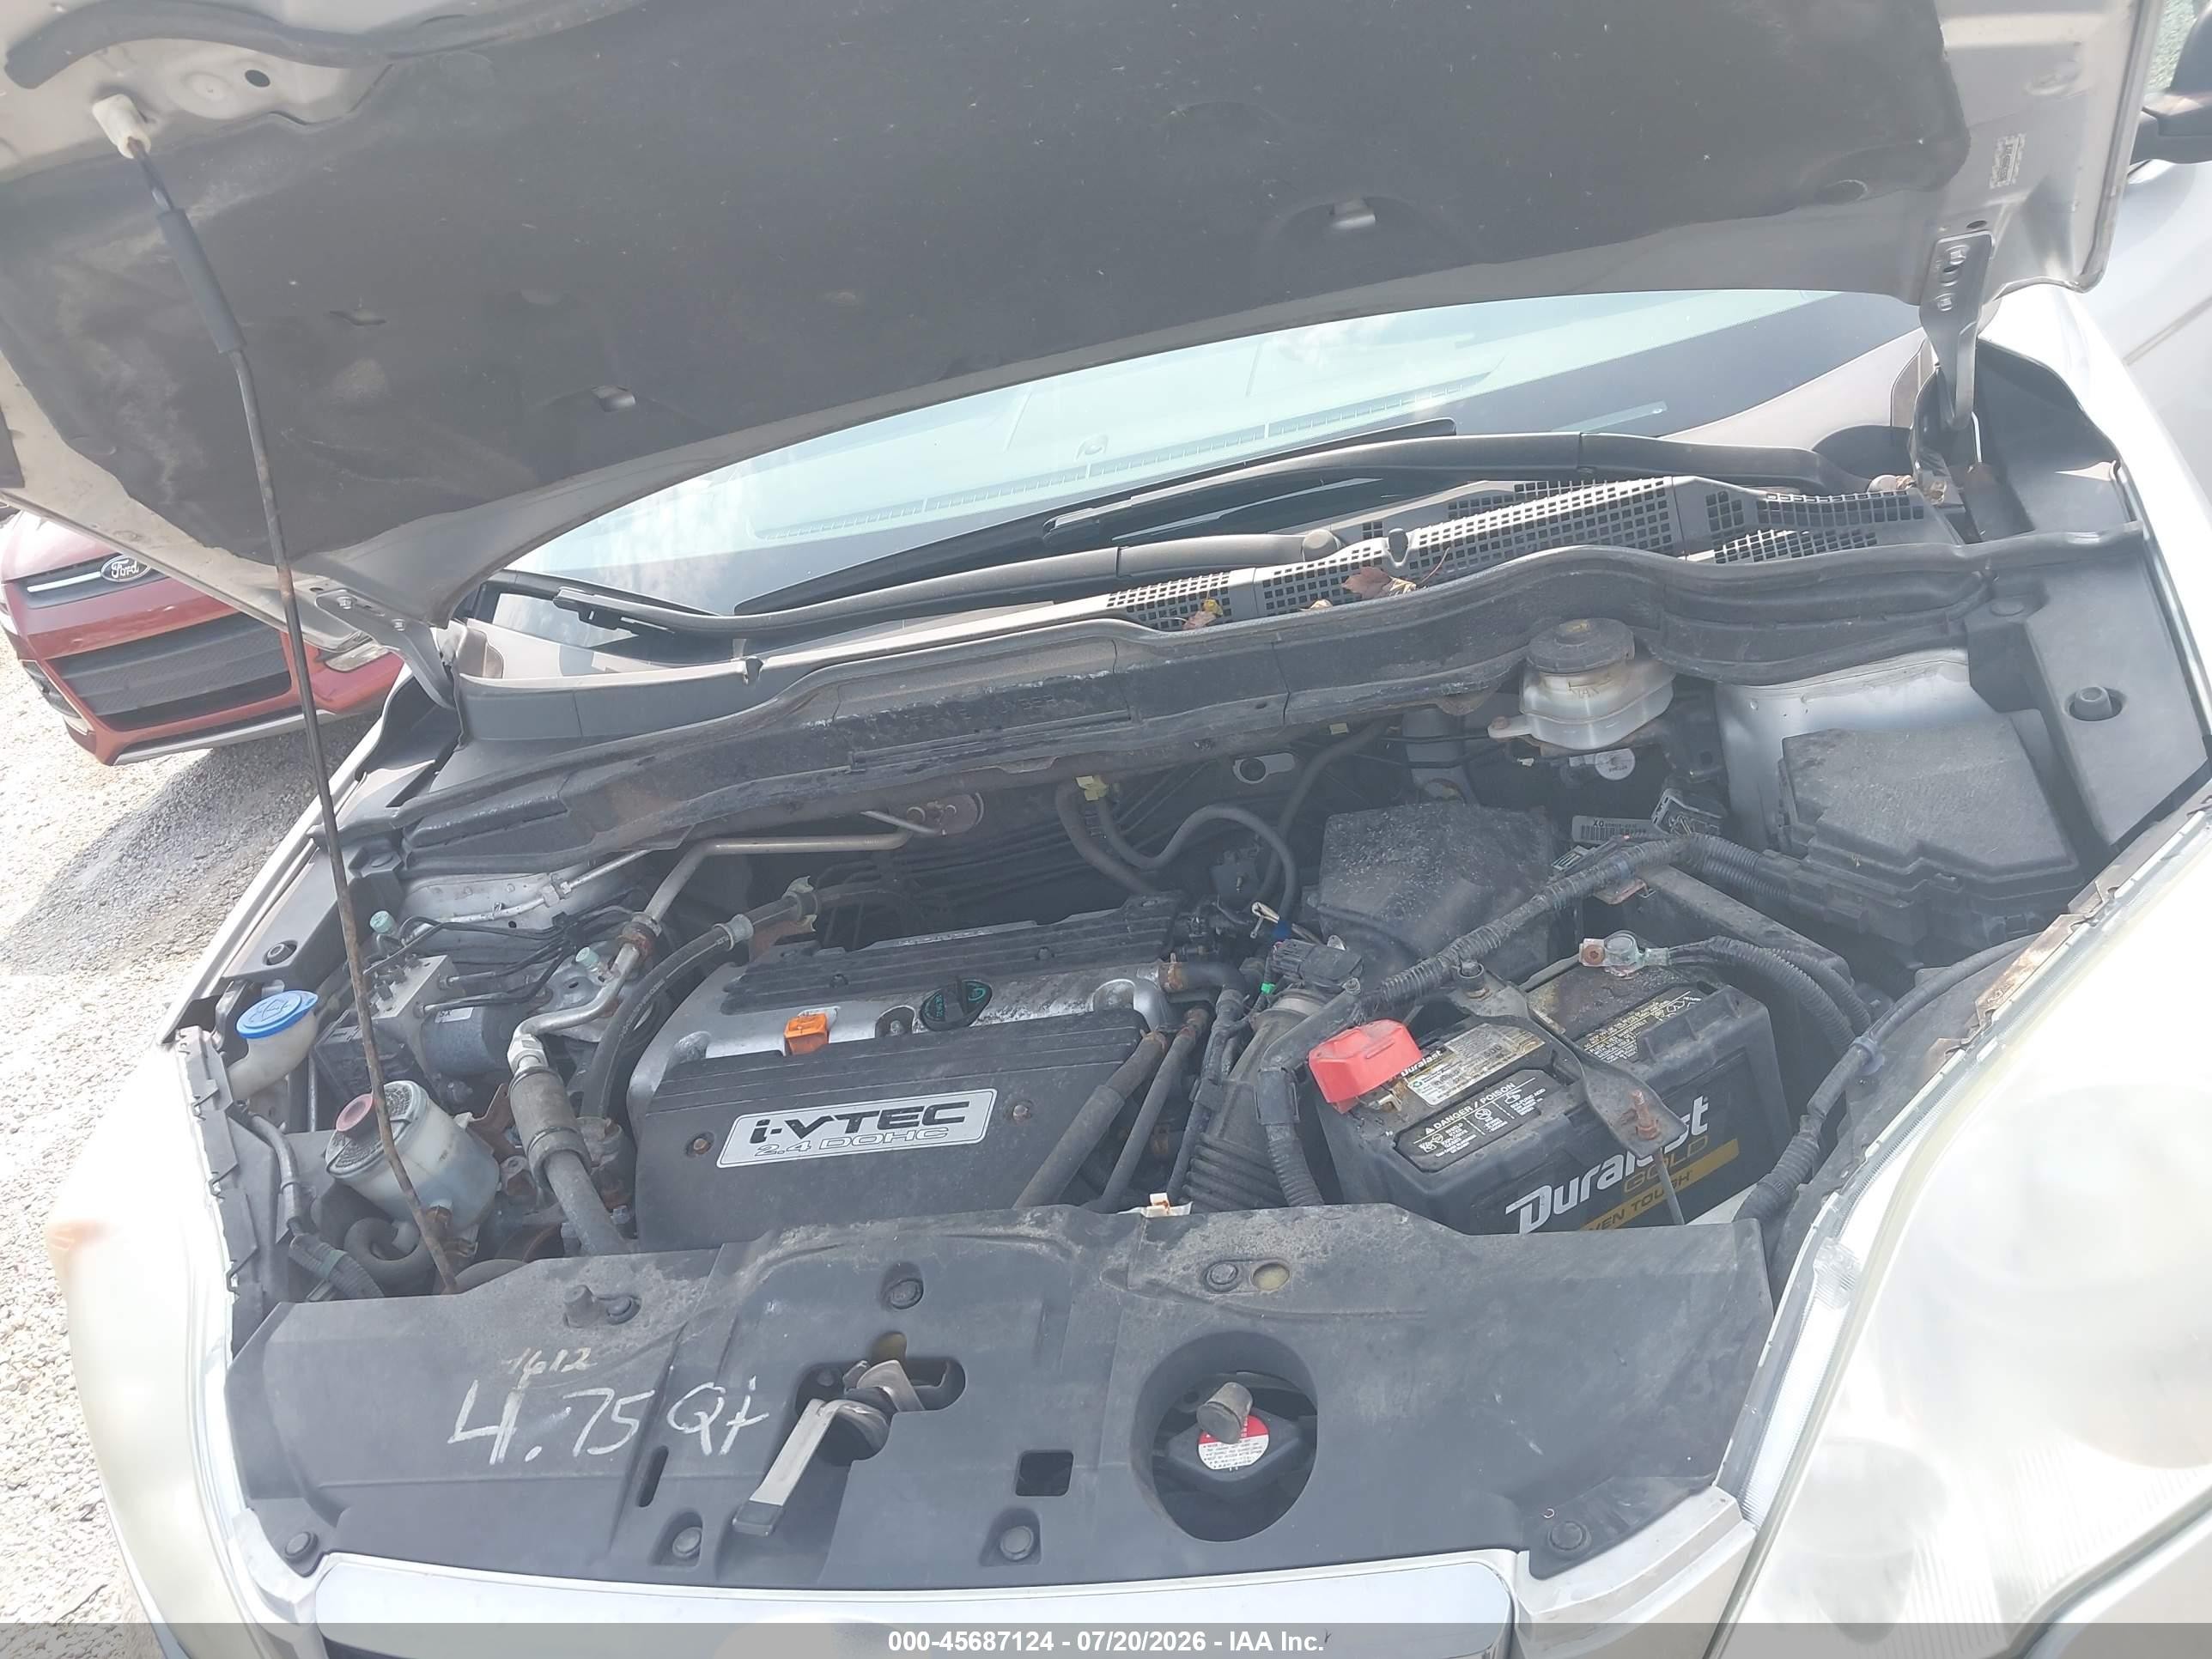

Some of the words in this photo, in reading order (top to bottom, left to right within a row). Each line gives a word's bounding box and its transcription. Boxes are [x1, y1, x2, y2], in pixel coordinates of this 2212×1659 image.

[111, 559, 139, 579] Ford
[750, 1102, 969, 1144] i-VTEC
[1433, 1106, 1474, 1129] DANGER
[1480, 1082, 1516, 1104] POISON
[754, 1140, 811, 1157] 2.4
[819, 1127, 949, 1150] DOHC
[447, 1380, 655, 1465] 4.75
